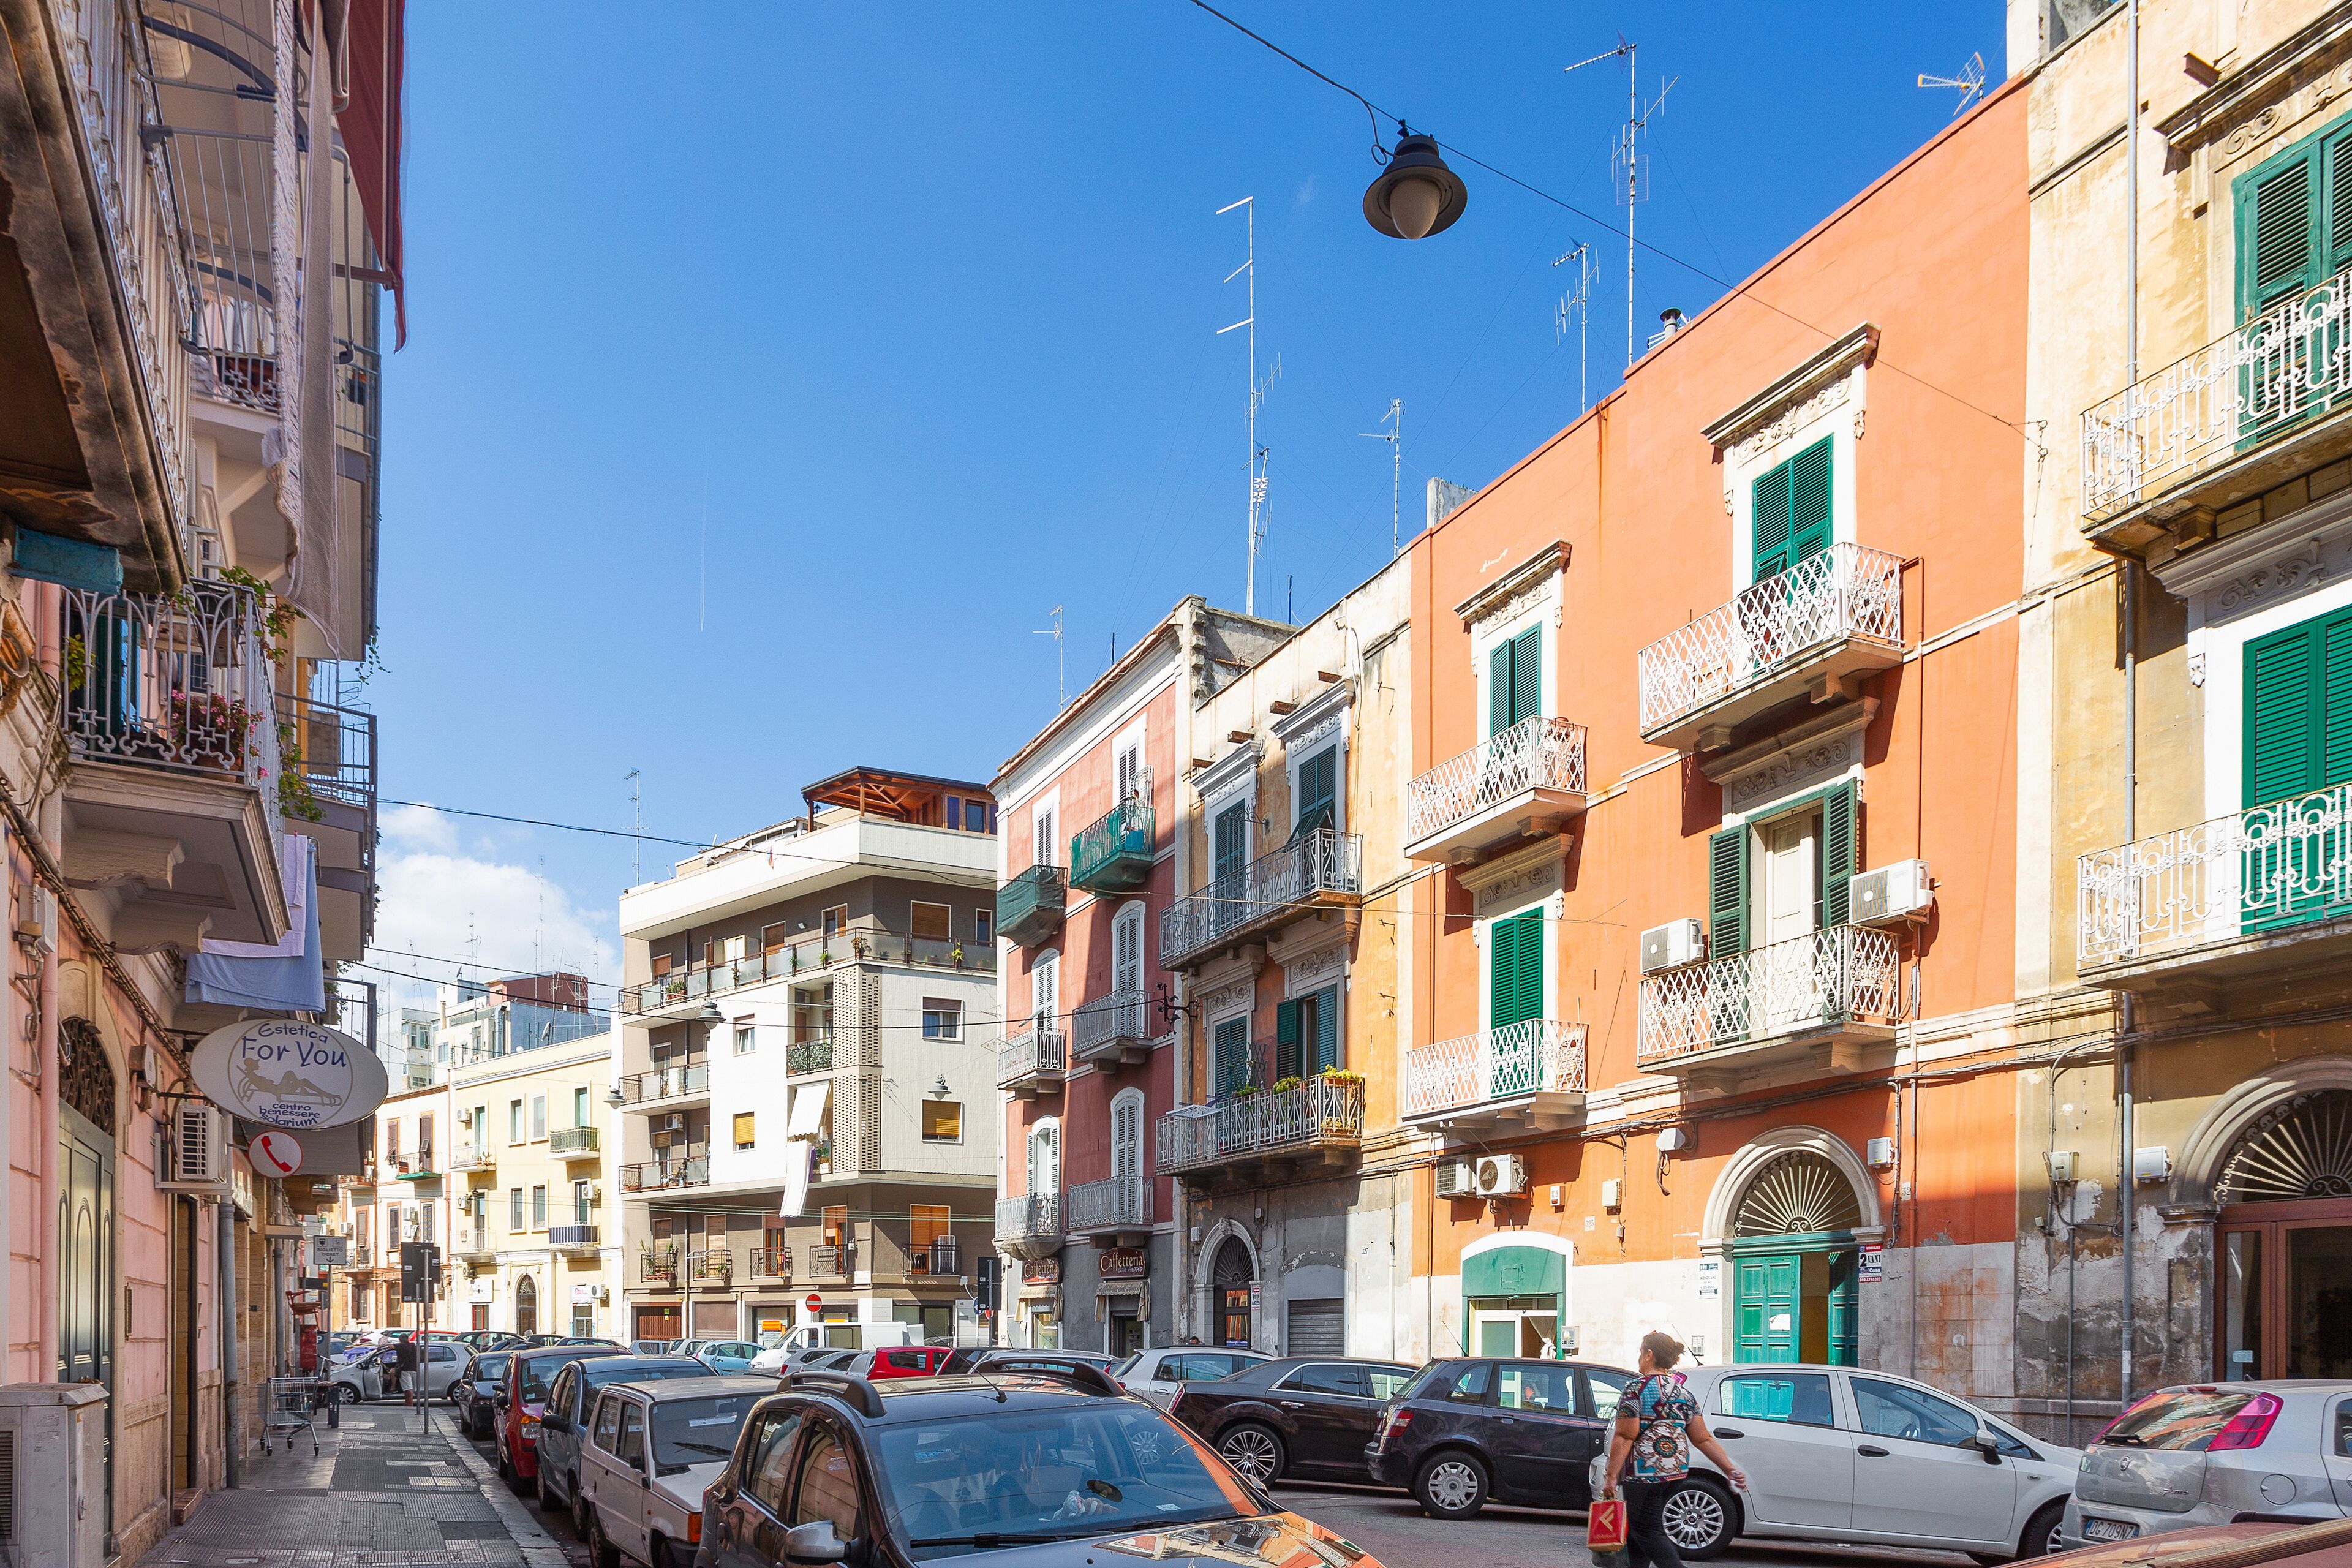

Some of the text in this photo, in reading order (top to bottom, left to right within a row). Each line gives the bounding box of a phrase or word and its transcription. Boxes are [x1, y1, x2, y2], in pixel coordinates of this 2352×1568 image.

[258, 1023, 328, 1044] Estetica
[241, 1035, 347, 1067] For You
[259, 1106, 321, 1118] benessere
[260, 1114, 318, 1127] solarium
[1100, 1251, 1144, 1272] Caffetteria
[1860, 1253, 1868, 1267] 2
